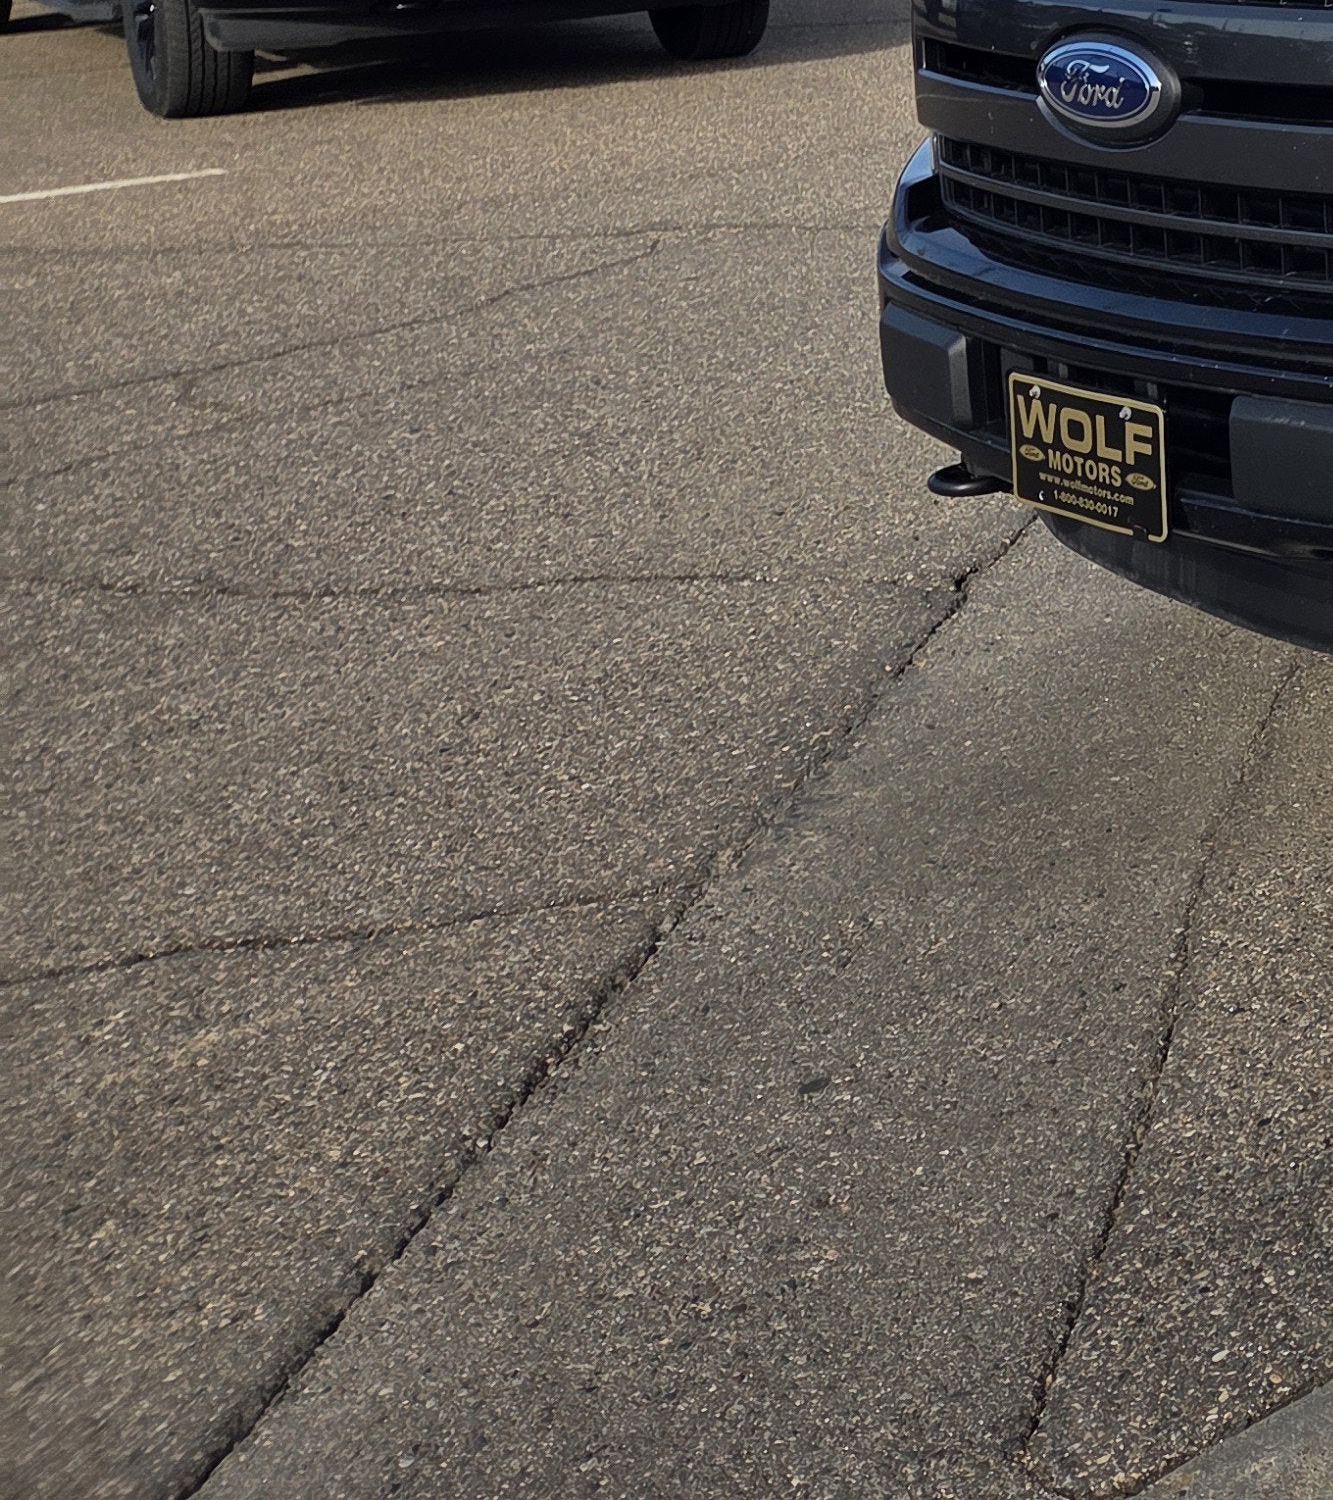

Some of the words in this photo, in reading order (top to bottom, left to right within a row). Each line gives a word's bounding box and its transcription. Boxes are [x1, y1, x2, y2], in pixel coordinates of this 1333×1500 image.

[1060, 59, 1125, 109] Ford
[1017, 394, 1153, 466] WOLF
[1038, 472, 1134, 505] www.wolfmotors.com
[1048, 449, 1121, 487] MOTORS
